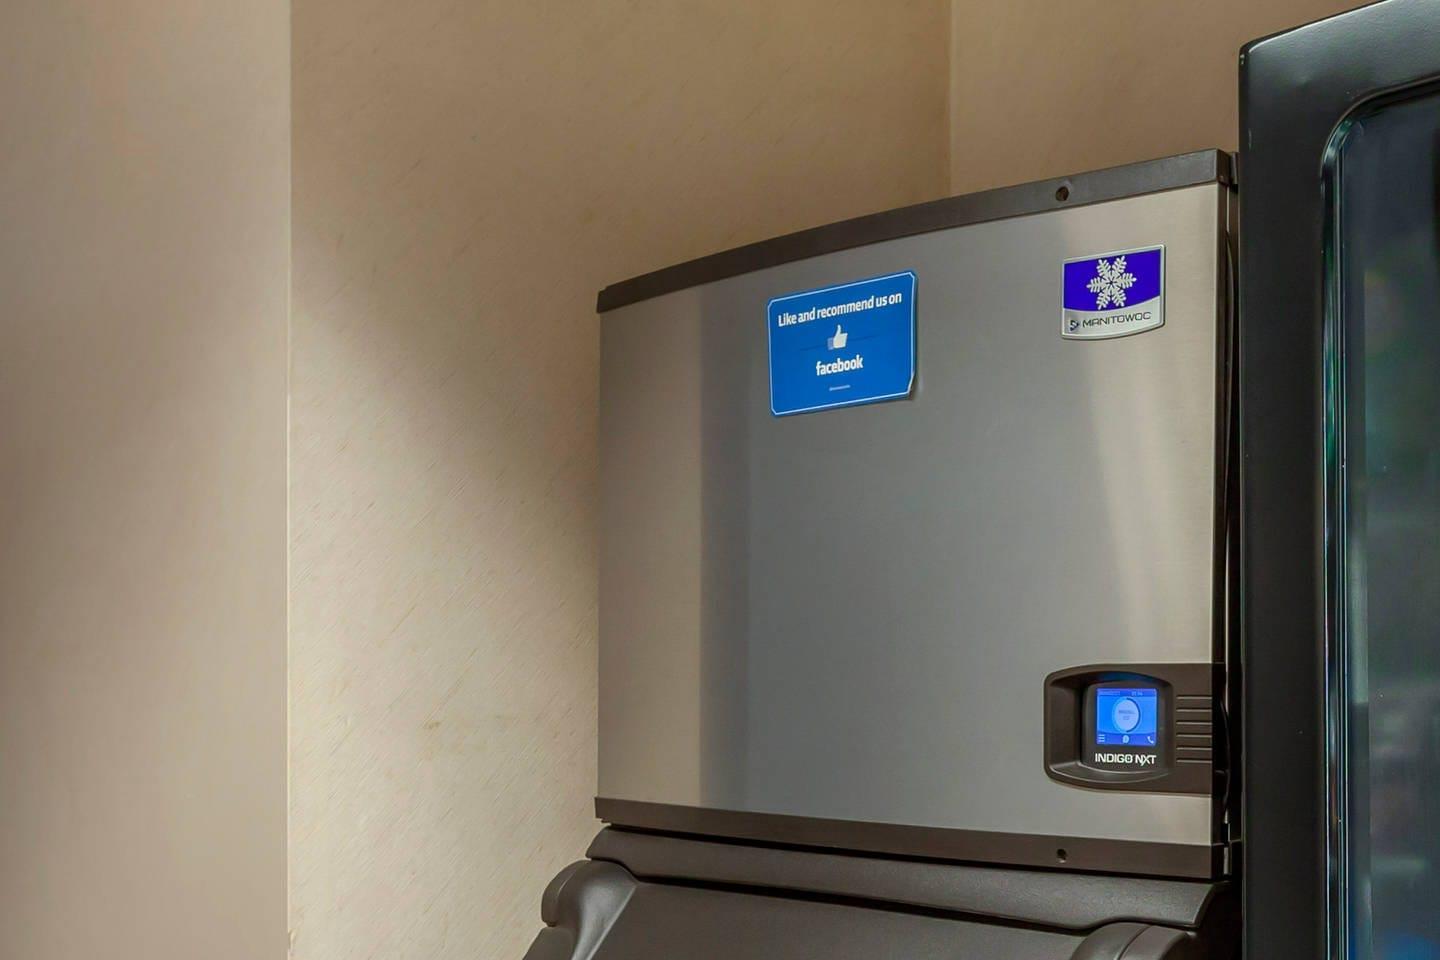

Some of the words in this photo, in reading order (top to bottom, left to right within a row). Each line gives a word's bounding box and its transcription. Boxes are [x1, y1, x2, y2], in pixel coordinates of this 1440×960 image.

[778, 312, 797, 327] Like
[798, 307, 815, 323] and
[817, 295, 875, 319] recommend
[876, 296, 888, 307] us
[888, 292, 902, 305] on
[1083, 312, 1151, 328] MANITOWOC
[816, 354, 863, 376] facebook
[1095, 753, 1133, 764] INDIGO
[1135, 753, 1157, 767] NXT
